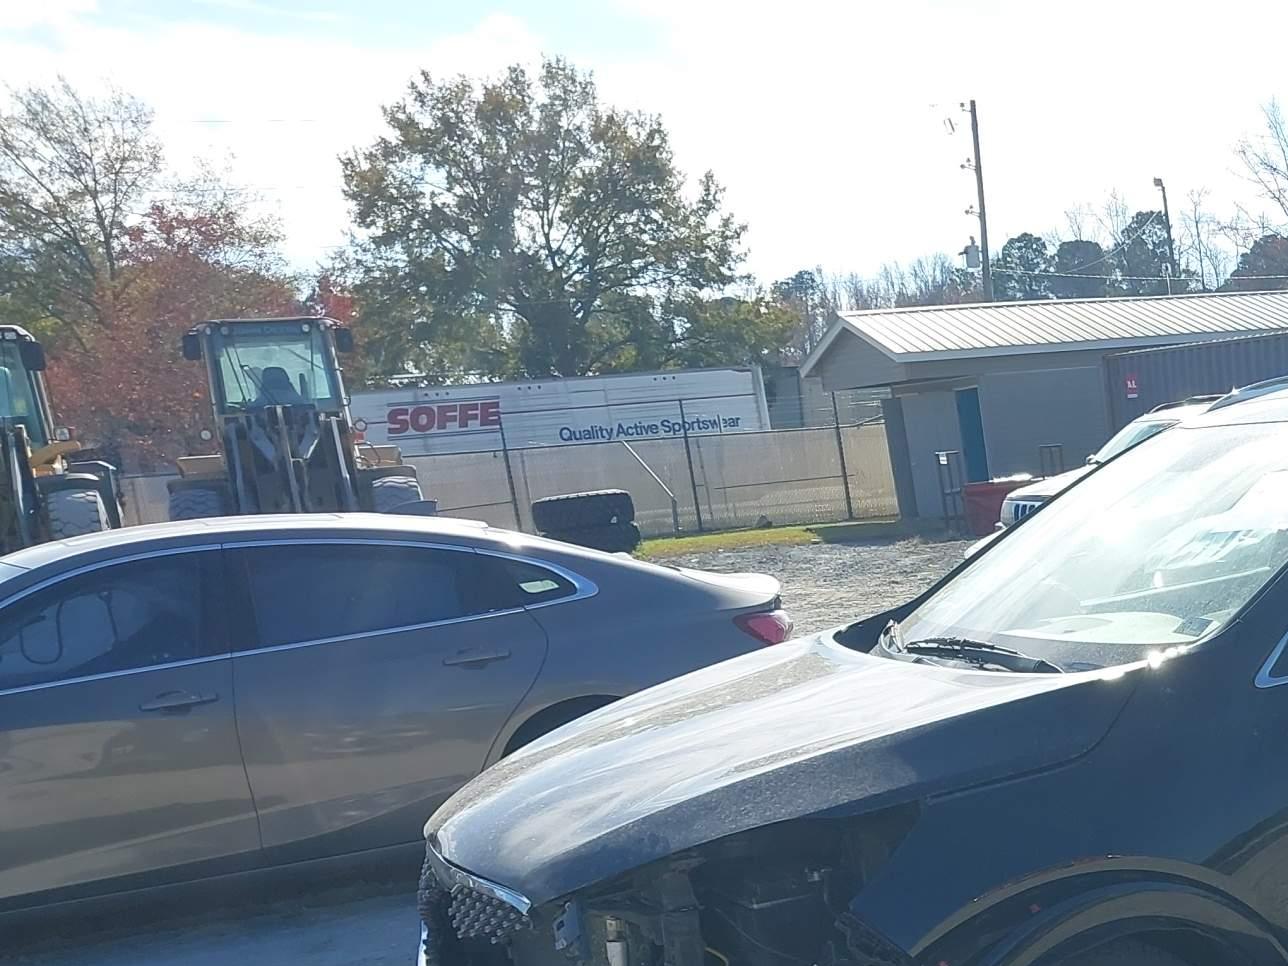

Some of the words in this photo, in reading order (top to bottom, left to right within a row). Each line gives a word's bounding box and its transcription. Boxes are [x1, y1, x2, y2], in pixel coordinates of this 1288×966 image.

[387, 401, 500, 434] SOFFE
[559, 425, 613, 441] Quality
[616, 421, 658, 437] Active
